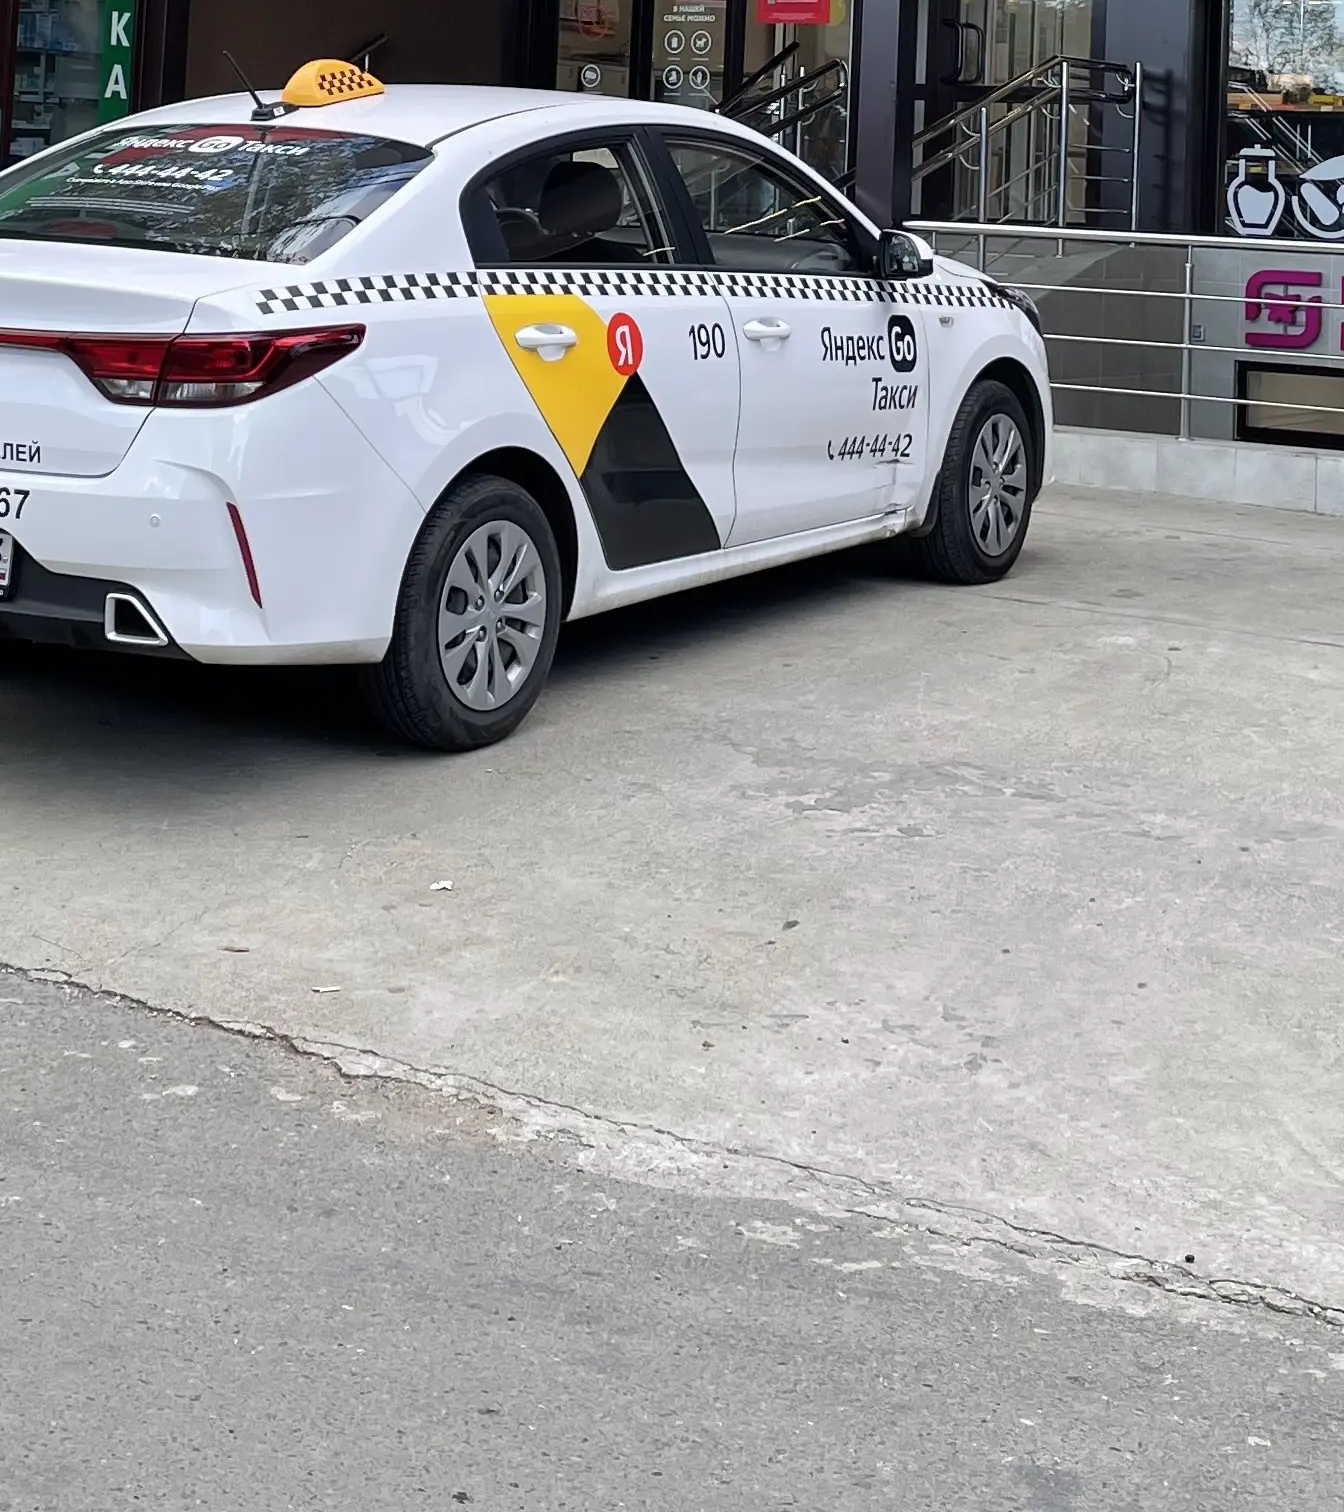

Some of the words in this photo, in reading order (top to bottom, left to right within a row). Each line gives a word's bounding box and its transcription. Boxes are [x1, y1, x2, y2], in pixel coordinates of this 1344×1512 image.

[237, 140, 310, 156] Такси
[108, 163, 234, 181] 444-44-42
[613, 324, 634, 366] Я
[688, 322, 726, 361] 190
[821, 326, 886, 367] Яндекс
[890, 326, 915, 364] Go
[871, 378, 918, 412] Такси
[836, 432, 913, 460] 444-44-42
